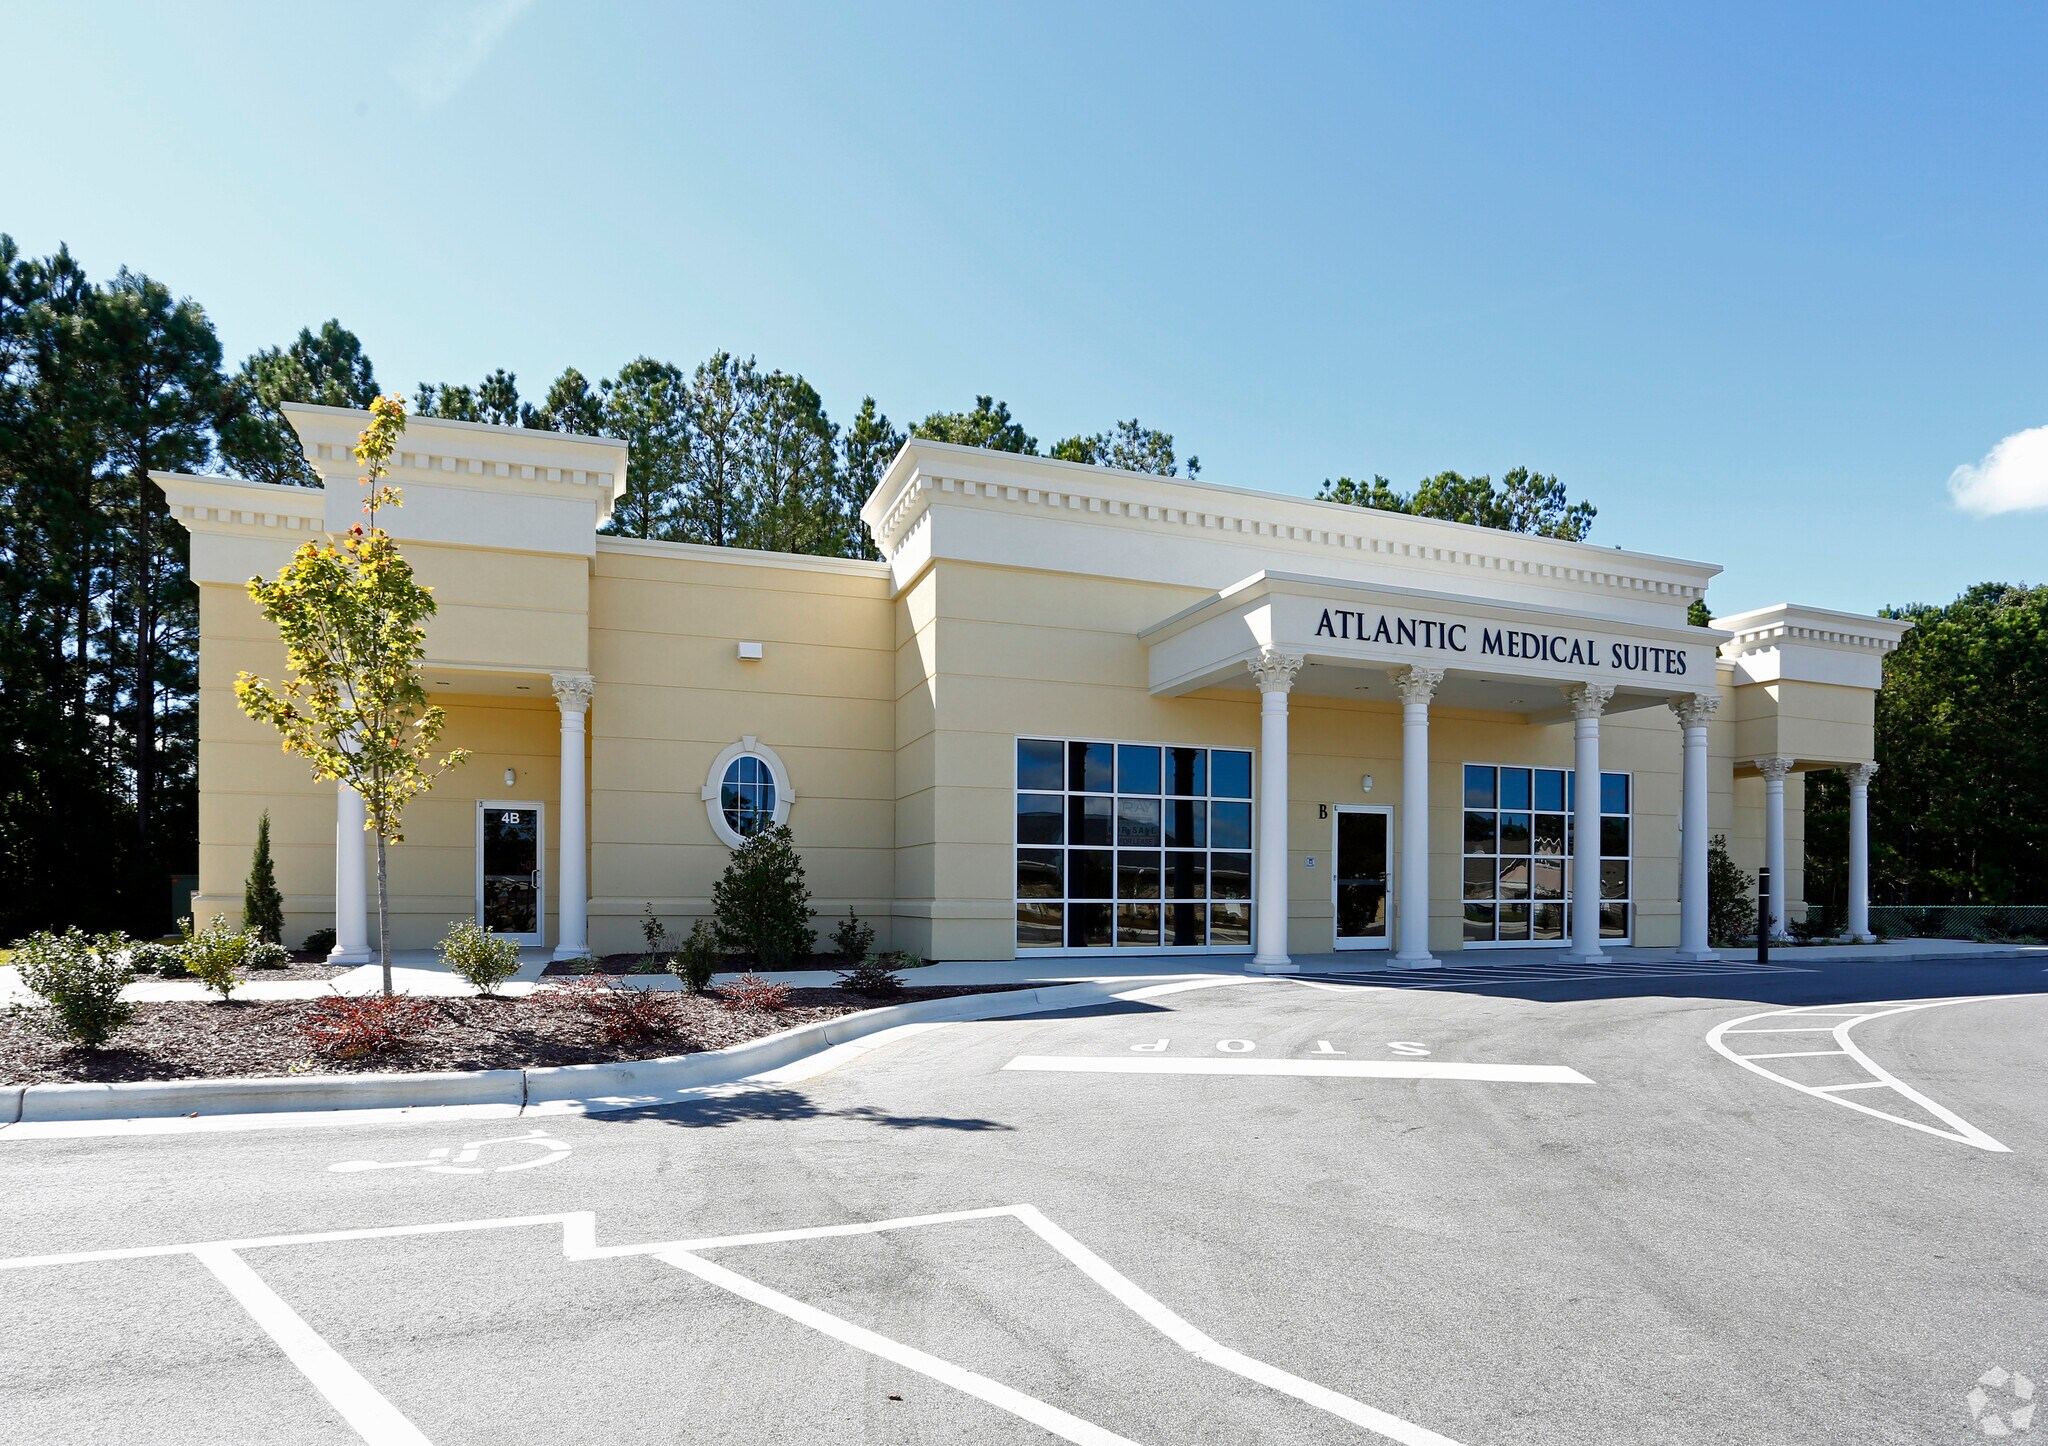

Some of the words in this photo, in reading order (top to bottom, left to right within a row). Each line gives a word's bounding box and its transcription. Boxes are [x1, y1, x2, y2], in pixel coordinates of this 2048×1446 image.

[1315, 608, 1467, 652] ATLANTIC
[1481, 627, 1600, 667] MEDICAL
[1611, 643, 1687, 675] SUITES
[501, 812, 520, 824] 4B
[1318, 804, 1328, 819] B
[1129, 1038, 1432, 1056] STOP
